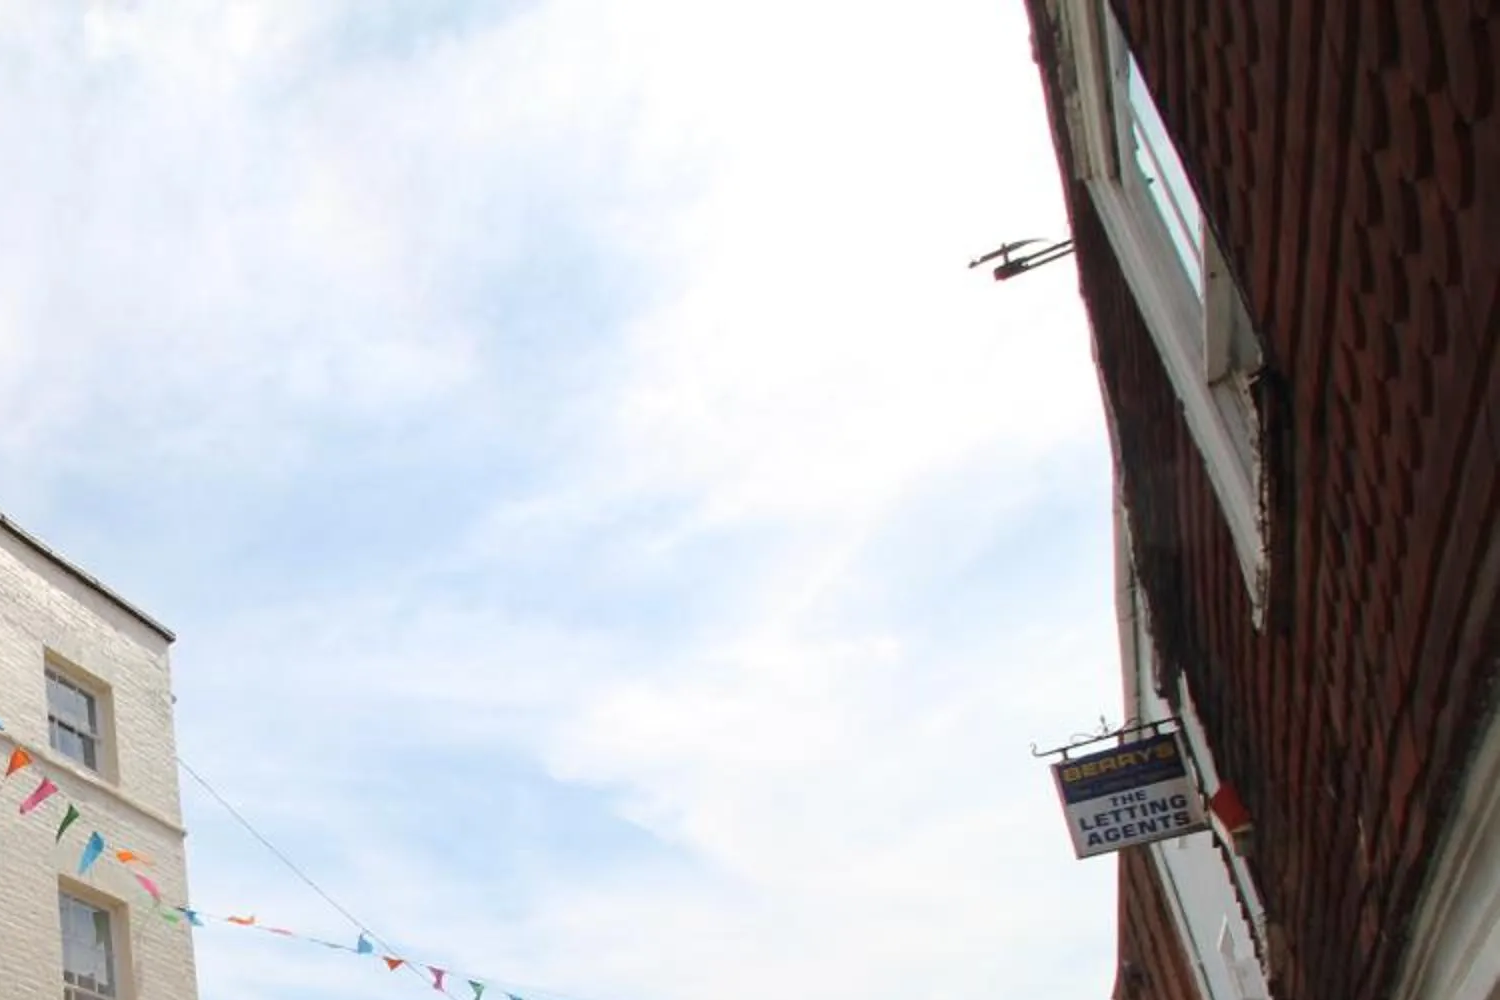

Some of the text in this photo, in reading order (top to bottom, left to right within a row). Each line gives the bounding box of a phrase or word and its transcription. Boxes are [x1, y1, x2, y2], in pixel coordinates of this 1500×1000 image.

[1079, 794, 1188, 831] LETTING
[1110, 789, 1147, 808] THE
[1088, 811, 1189, 847] AGENTS
